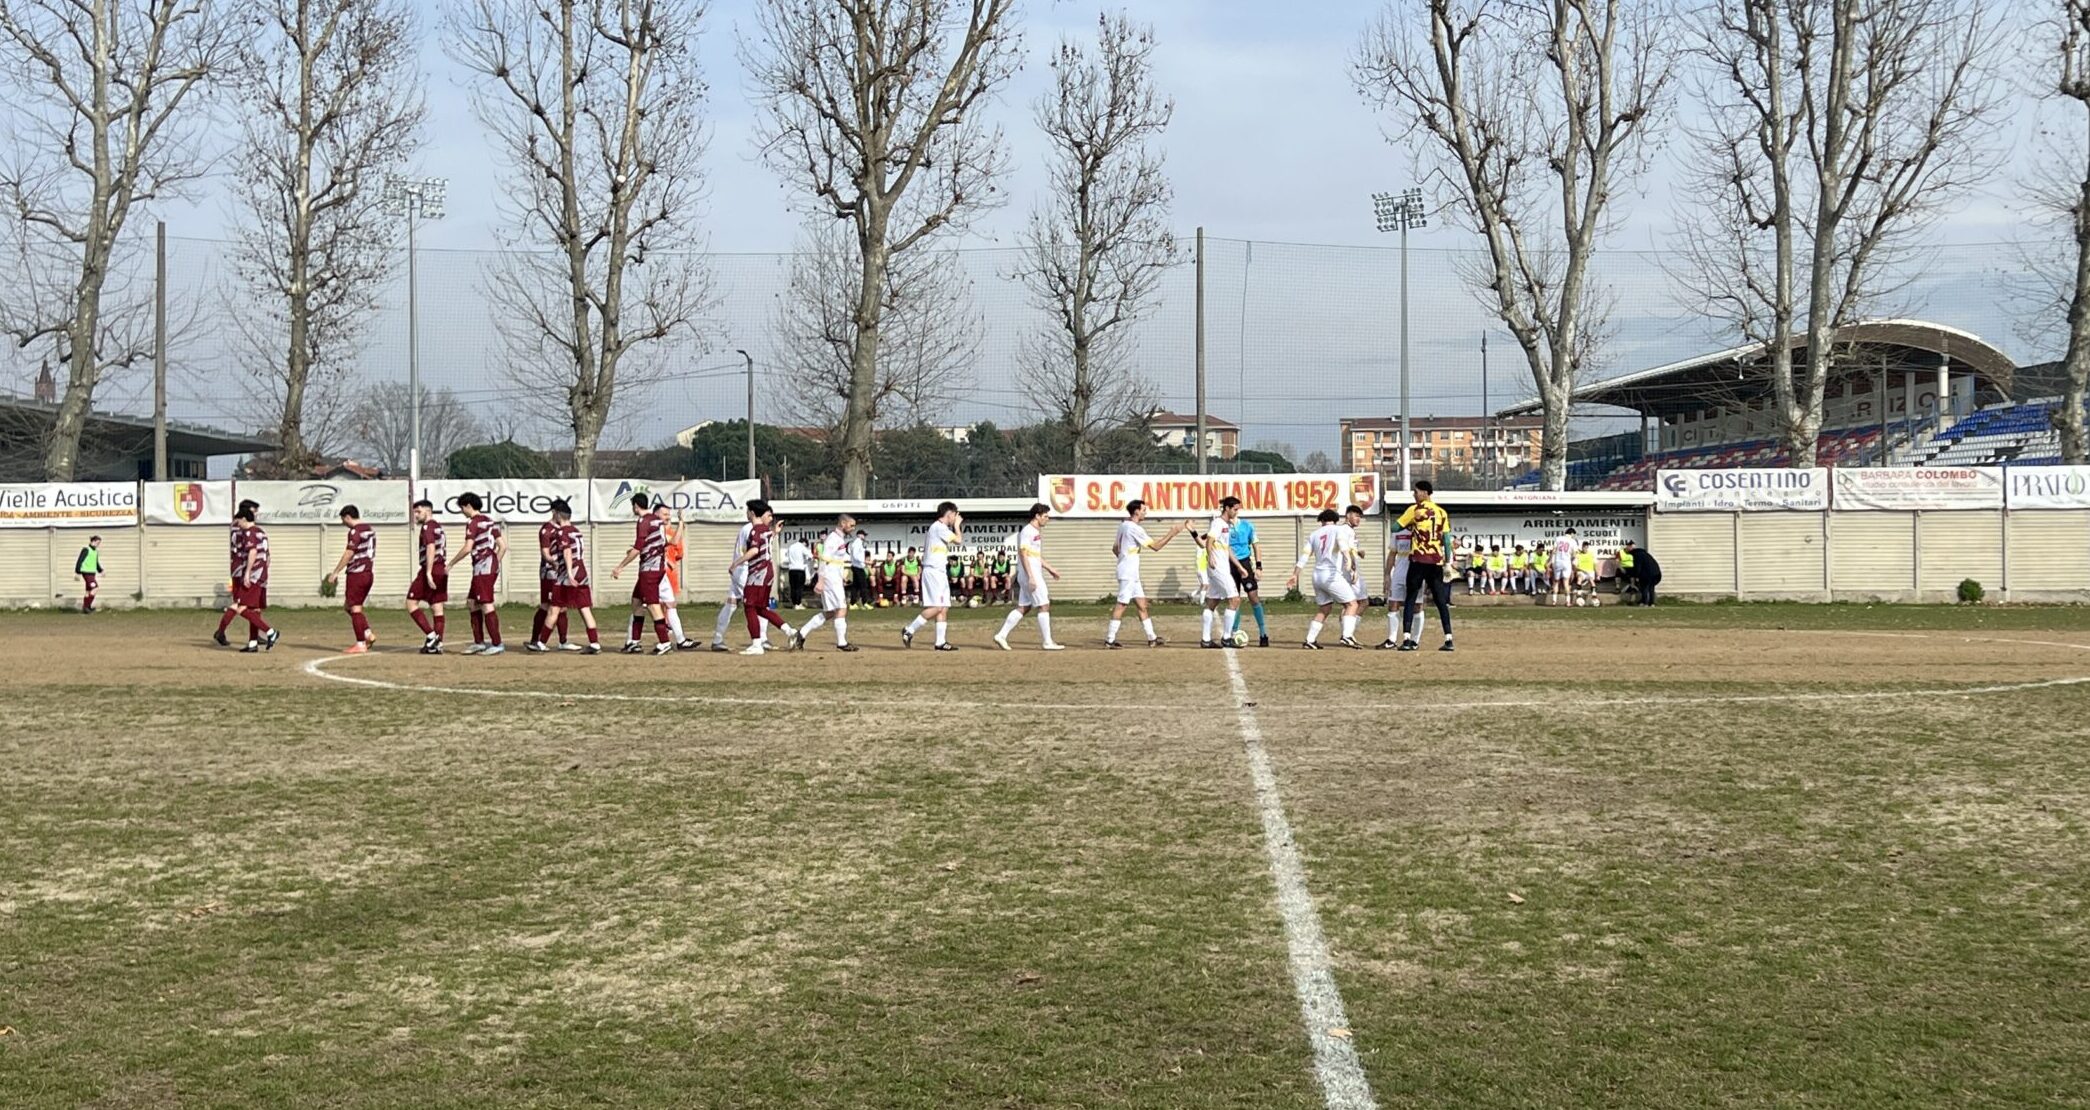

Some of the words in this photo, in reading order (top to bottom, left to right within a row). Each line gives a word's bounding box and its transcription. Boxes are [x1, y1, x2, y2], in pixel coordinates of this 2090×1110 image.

[1700, 472, 1811, 490] COSENTINO
[1861, 471, 1912, 480] BARBARA
[1916, 470, 1977, 480] COLOMBO
[54, 488, 134, 508] Acustica
[1141, 480, 1279, 511] ANTONIANA
[1284, 480, 1339, 510] 1952
[1664, 500, 1705, 509] Impianti
[1714, 500, 1734, 508] Idro
[1744, 499, 1773, 507] Termo
[1782, 498, 1822, 507] Sanitari
[22, 511, 73, 519] AMBIENTE
[79, 509, 133, 518] SICUREZZA
[1429, 516, 1439, 542] 1
[1319, 534, 1328, 554] 7
[1558, 541, 1570, 553] 20
